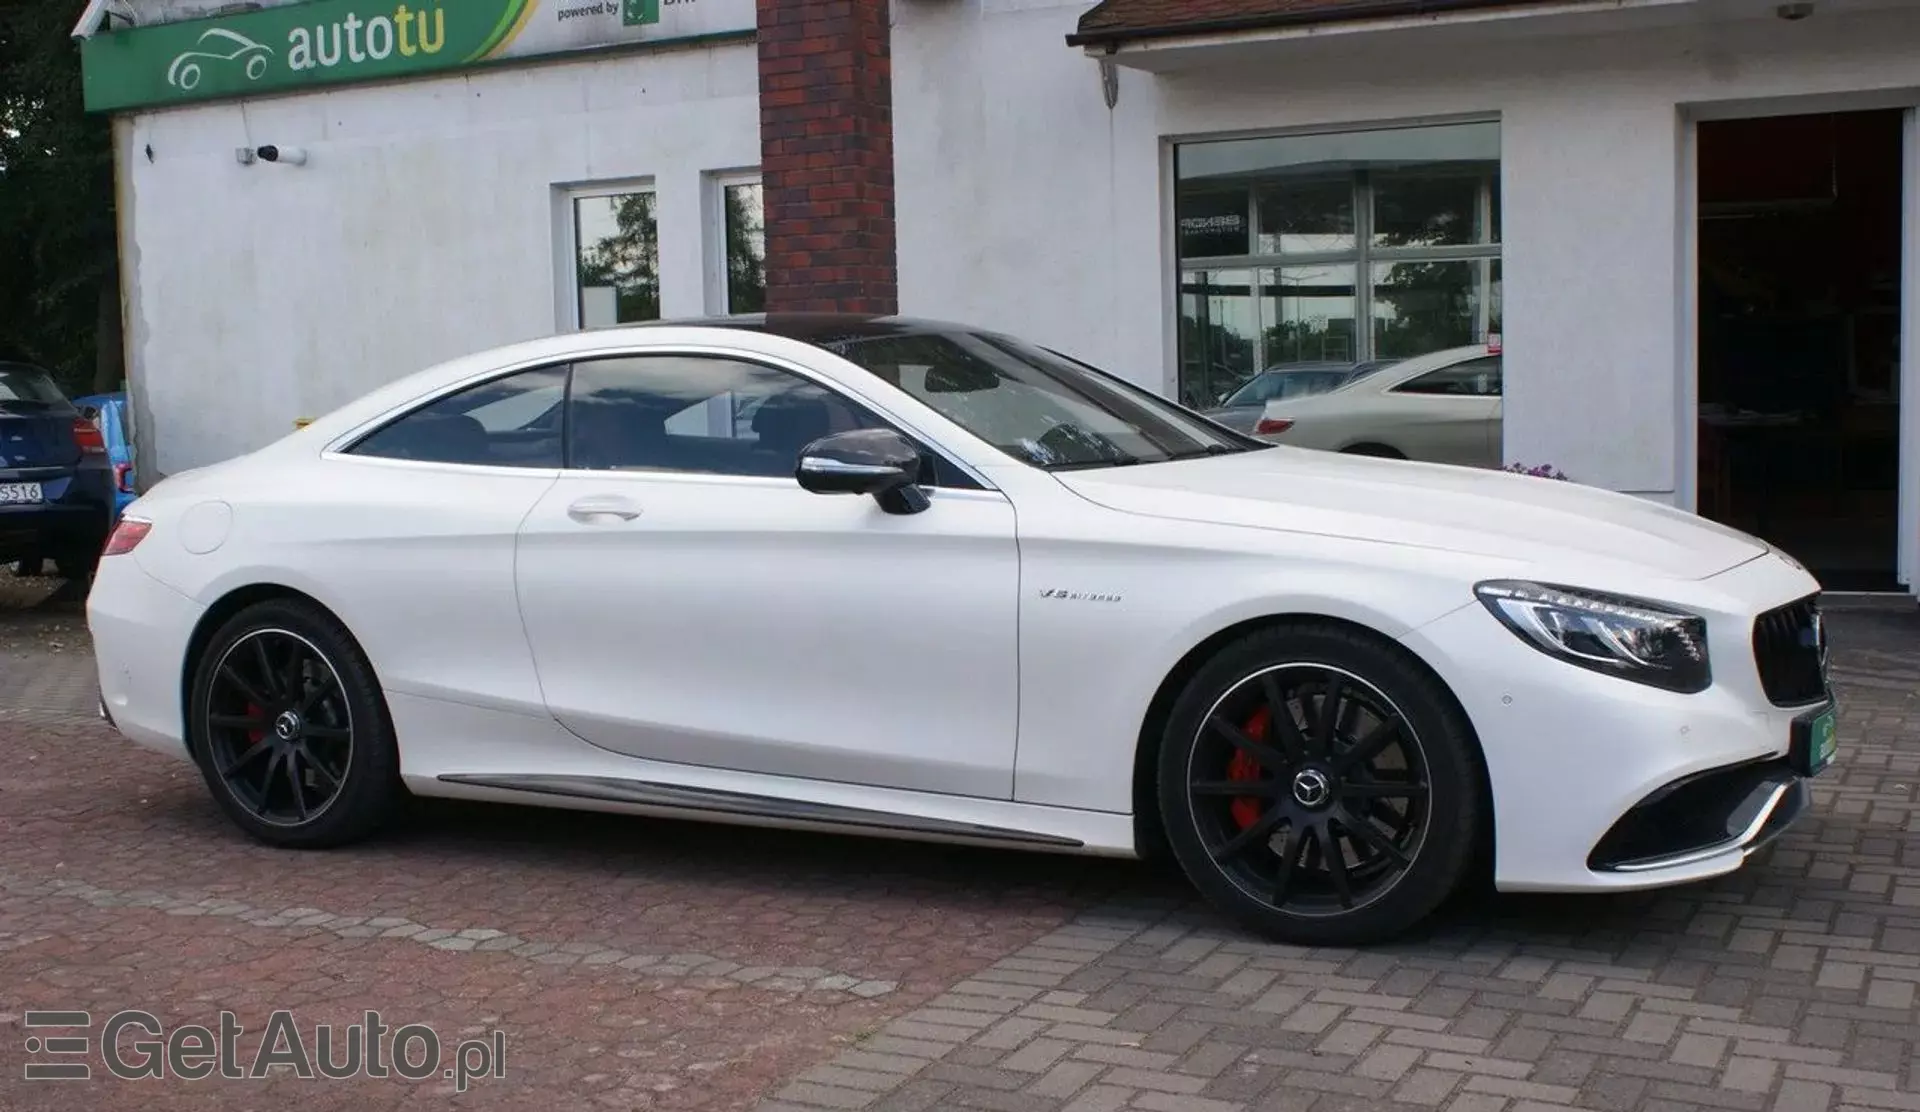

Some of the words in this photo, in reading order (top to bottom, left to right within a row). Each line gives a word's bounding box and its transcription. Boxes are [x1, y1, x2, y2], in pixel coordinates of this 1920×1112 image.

[558, 3, 604, 22] powered
[606, 1, 619, 15] by
[288, 4, 445, 71] autotu
